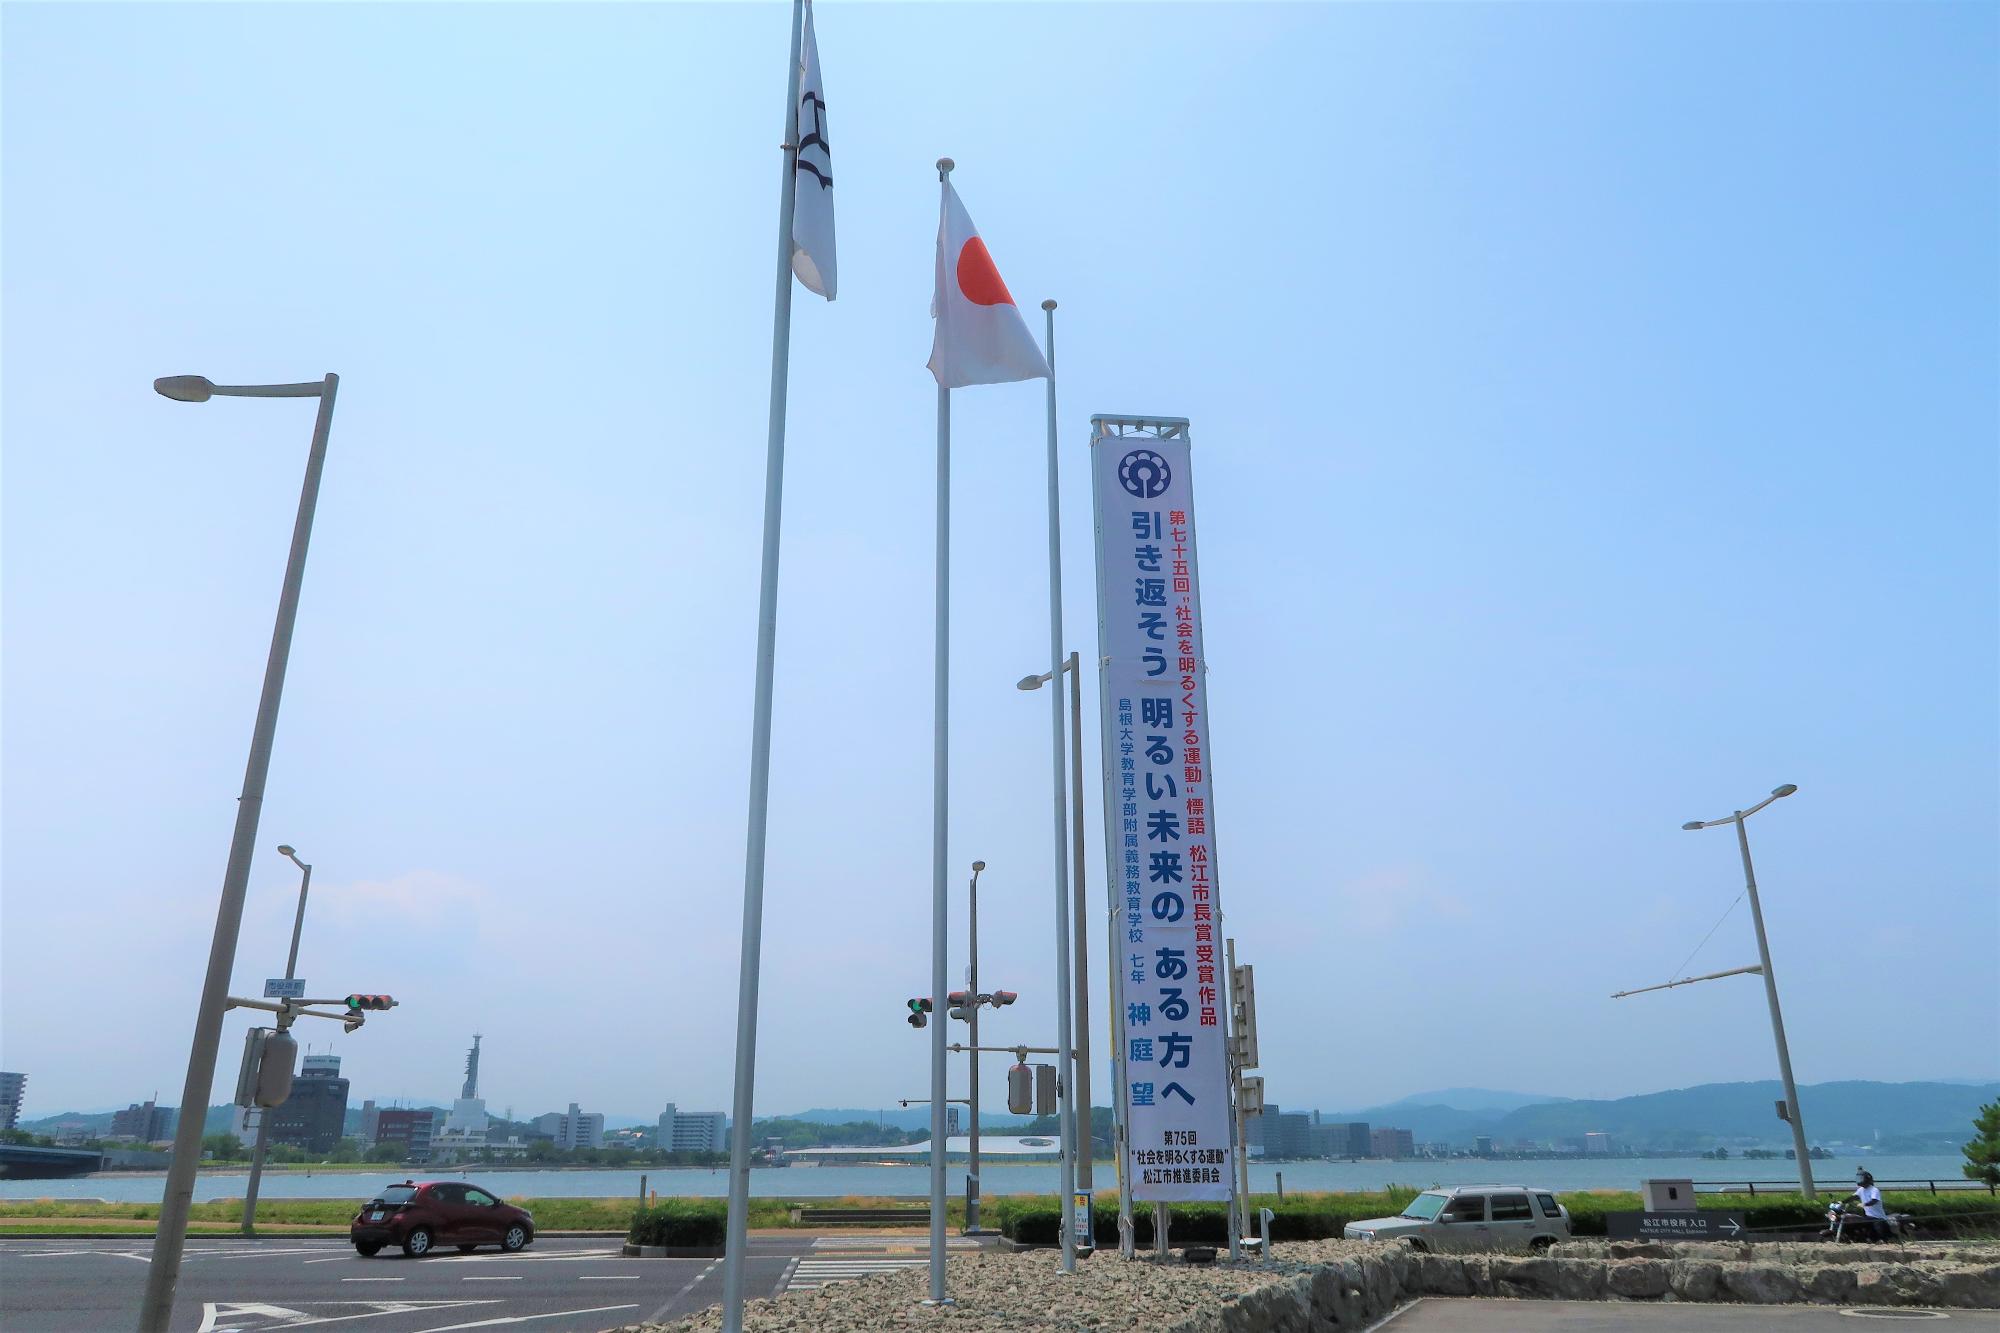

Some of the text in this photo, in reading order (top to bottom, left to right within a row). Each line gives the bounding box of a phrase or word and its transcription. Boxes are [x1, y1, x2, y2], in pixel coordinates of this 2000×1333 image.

[1118, 698, 1144, 943] 島根大学教育学部附属義務教育学校
[1131, 511, 1196, 1106] 引き返そう 明るい未来の ある方へ
[1143, 1168, 1220, 1184] 松江市推進委員会
[1164, 1130, 1197, 1146] 第75回
